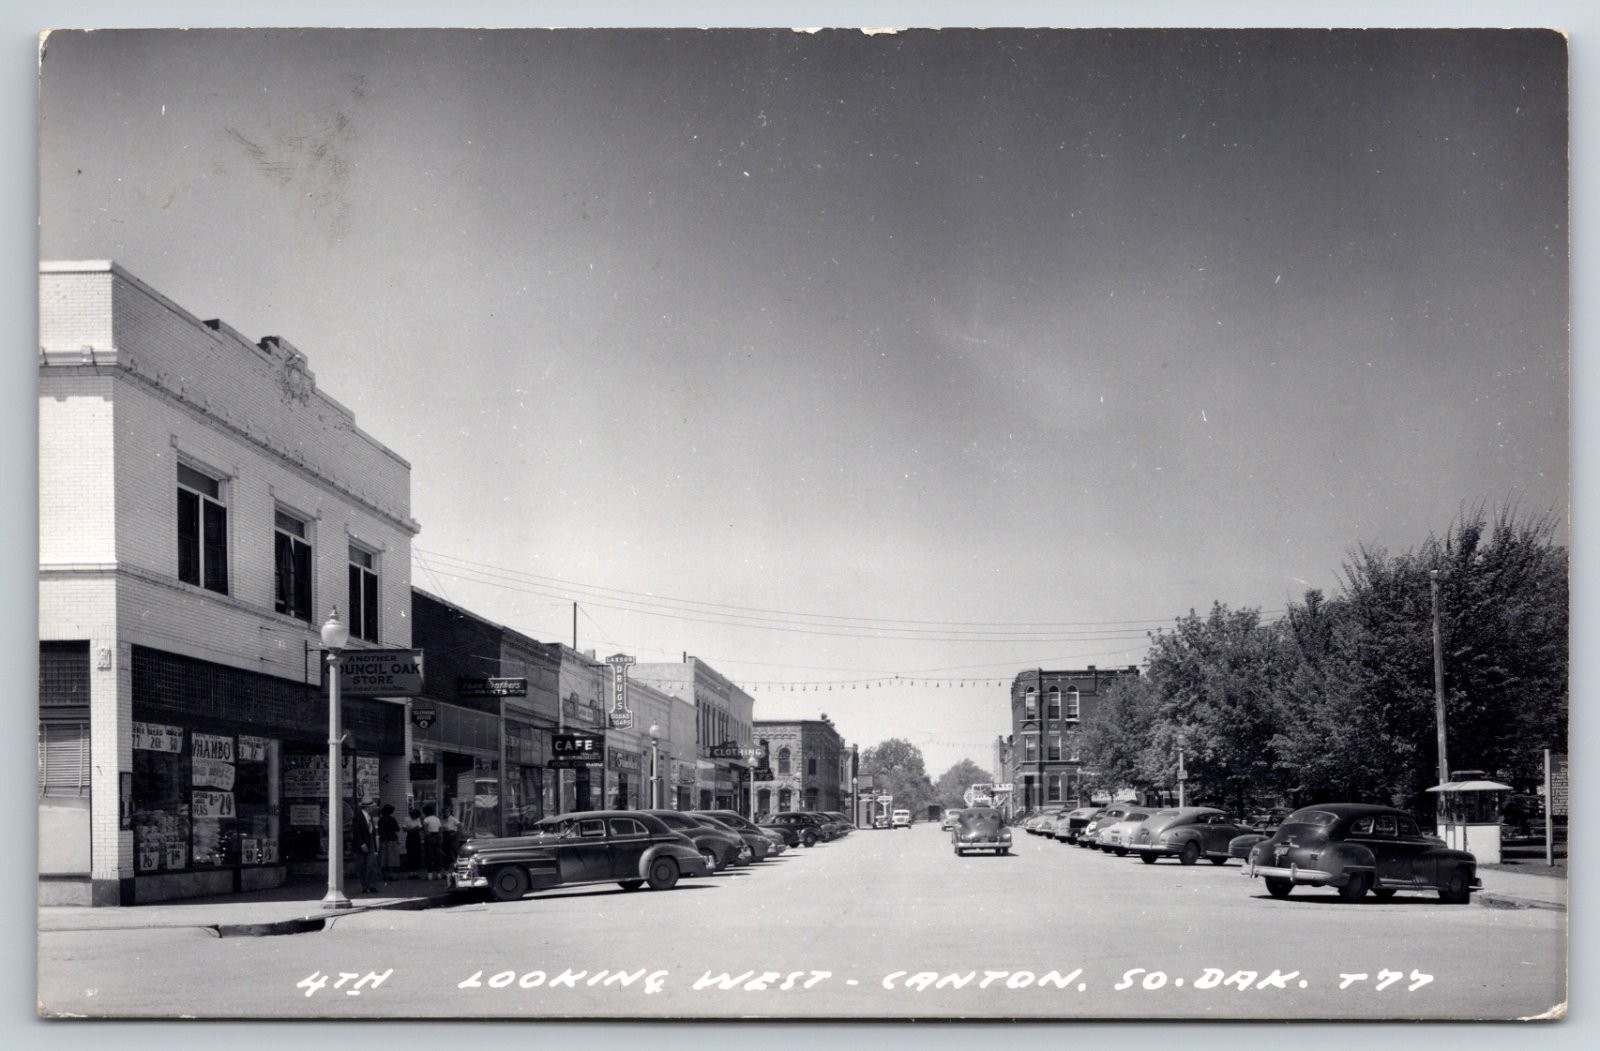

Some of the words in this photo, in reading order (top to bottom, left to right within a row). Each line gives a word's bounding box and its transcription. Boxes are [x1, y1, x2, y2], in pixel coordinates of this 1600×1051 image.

[391, 663, 420, 675] OAK
[352, 675, 394, 685] STORE
[554, 740, 593, 751] CAFE
[713, 748, 762, 757] CLOTHING
